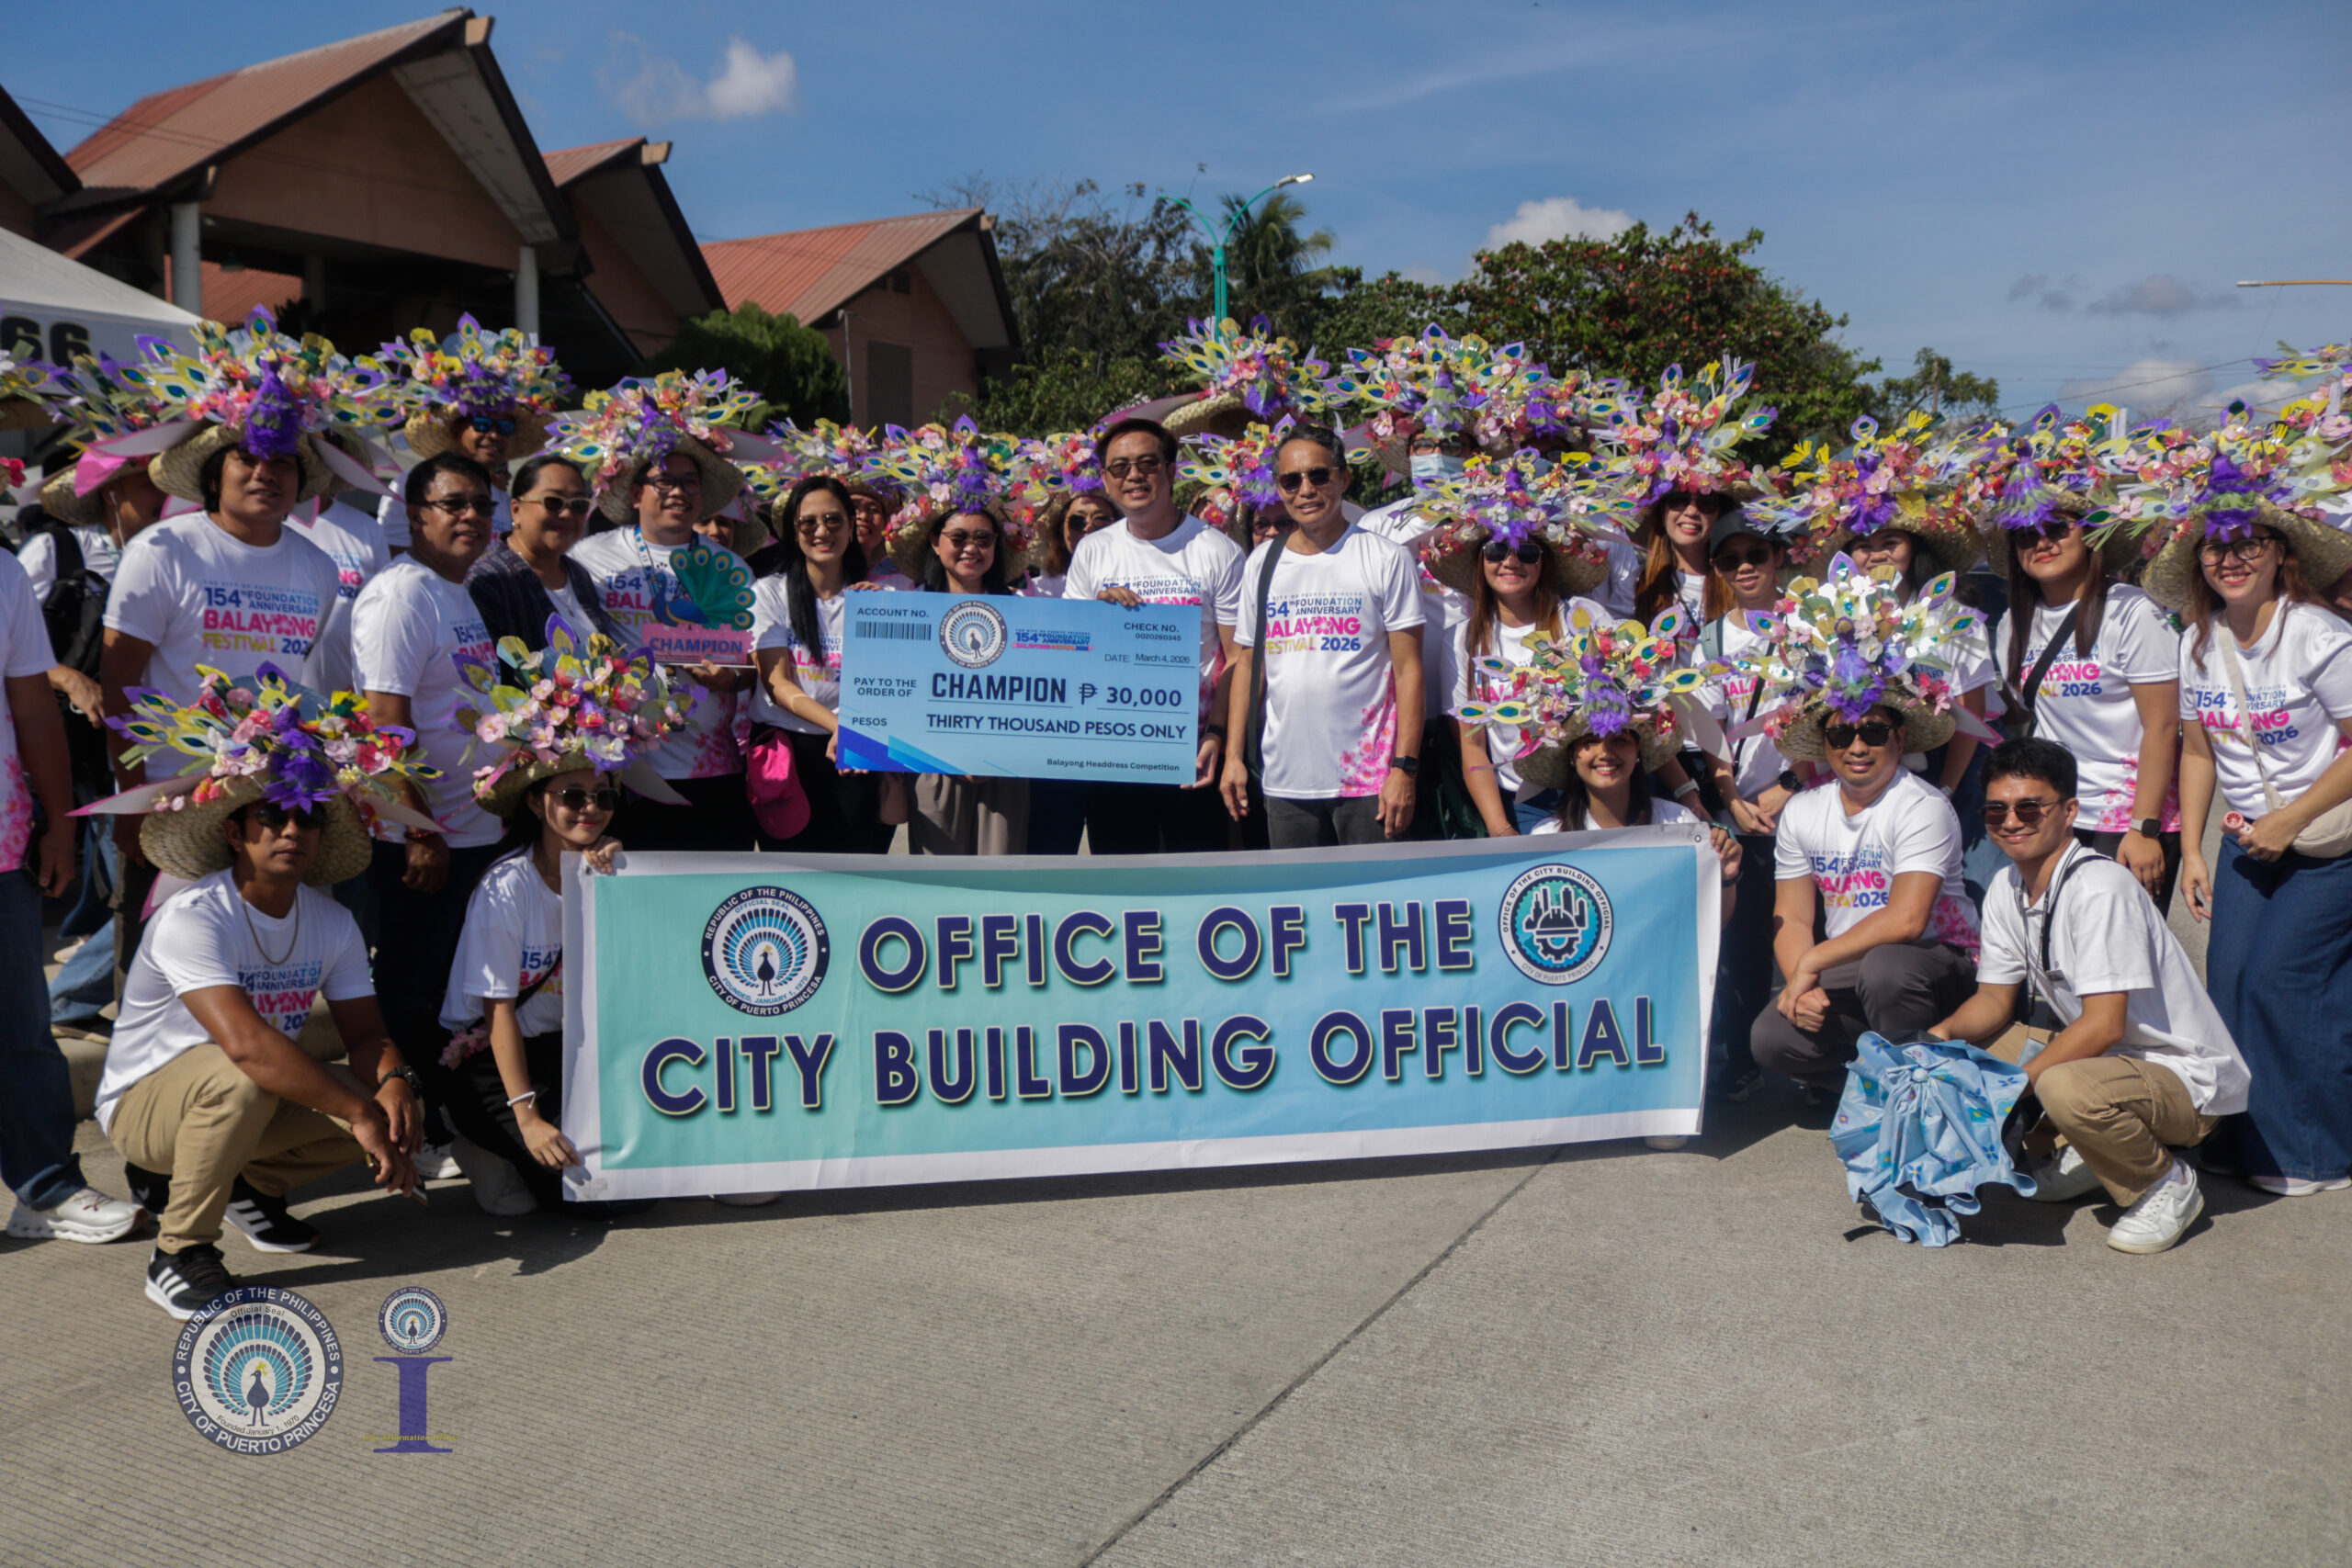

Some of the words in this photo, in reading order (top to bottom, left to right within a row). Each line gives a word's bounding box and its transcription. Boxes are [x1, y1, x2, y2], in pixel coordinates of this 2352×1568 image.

[247, 591, 319, 606] FOUNDATION
[249, 600, 319, 616] ANNIVERSARY
[857, 607, 909, 618] ACCOUNT
[910, 610, 930, 618] NO.
[1266, 601, 1296, 618] 54th
[1295, 597, 1363, 608] FOUNDATION
[1295, 606, 1362, 616] ANNIVERSARY
[1124, 622, 1159, 632] CHECK
[1161, 624, 1180, 633] NO.
[1135, 633, 1182, 642] 0020260345
[1320, 637, 1362, 652] 2026
[649, 637, 743, 654] CHAMPION
[1135, 653, 1160, 663] March
[1161, 655, 1170, 663] 4,
[1170, 655, 1191, 664] 2026
[854, 677, 876, 686] PAY
[878, 678, 893, 687] TO
[895, 679, 917, 688] THE
[931, 671, 1067, 704] CHAMPION
[1105, 686, 1182, 708] 30,000
[2061, 682, 2103, 697] 2026
[857, 687, 896, 697] ORDER
[897, 688, 912, 697] OF
[852, 716, 888, 727] PESOS
[926, 714, 985, 730] THIRTY
[987, 716, 1080, 735] THOUSAND
[1084, 721, 1136, 737] PESOS
[1140, 723, 1188, 739] ONLY
[1046, 758, 1084, 768] Balayong
[1085, 759, 1128, 770] Headdress
[1129, 761, 1181, 773] Competition
[734, 898, 769, 914] OFFICIAL
[771, 900, 790, 911] SEAL
[1503, 901, 1512, 932] OFFICE
[1510, 889, 1519, 898] OF
[1518, 874, 1532, 887] THE
[1534, 867, 1554, 877] CITY
[1556, 867, 1596, 890] BUILDING
[1595, 890, 1611, 931] OFFICIAL
[705, 897, 739, 940] REPUBLIC
[740, 889, 753, 900] OF
[756, 888, 777, 897] THE
[778, 888, 825, 936] PHILIPPINES
[857, 909, 1164, 992] OFFICE
[1197, 904, 1306, 980] OF
[1333, 897, 1473, 974] THE
[1521, 963, 1534, 976] CITY
[1534, 971, 1542, 979] OF
[1543, 974, 1566, 982] PUERTO
[1567, 960, 1595, 979] PRINCESA
[708, 976, 727, 996] CITY
[725, 995, 740, 1007] OF
[740, 1002, 780, 1016] PUERTO
[782, 976, 823, 1012] PRINCESA
[753, 993, 787, 1004] JANUARY
[640, 1032, 834, 1116] CITY
[872, 1013, 1276, 1104] BUILDING
[1309, 995, 1665, 1084] OFFICIAL
